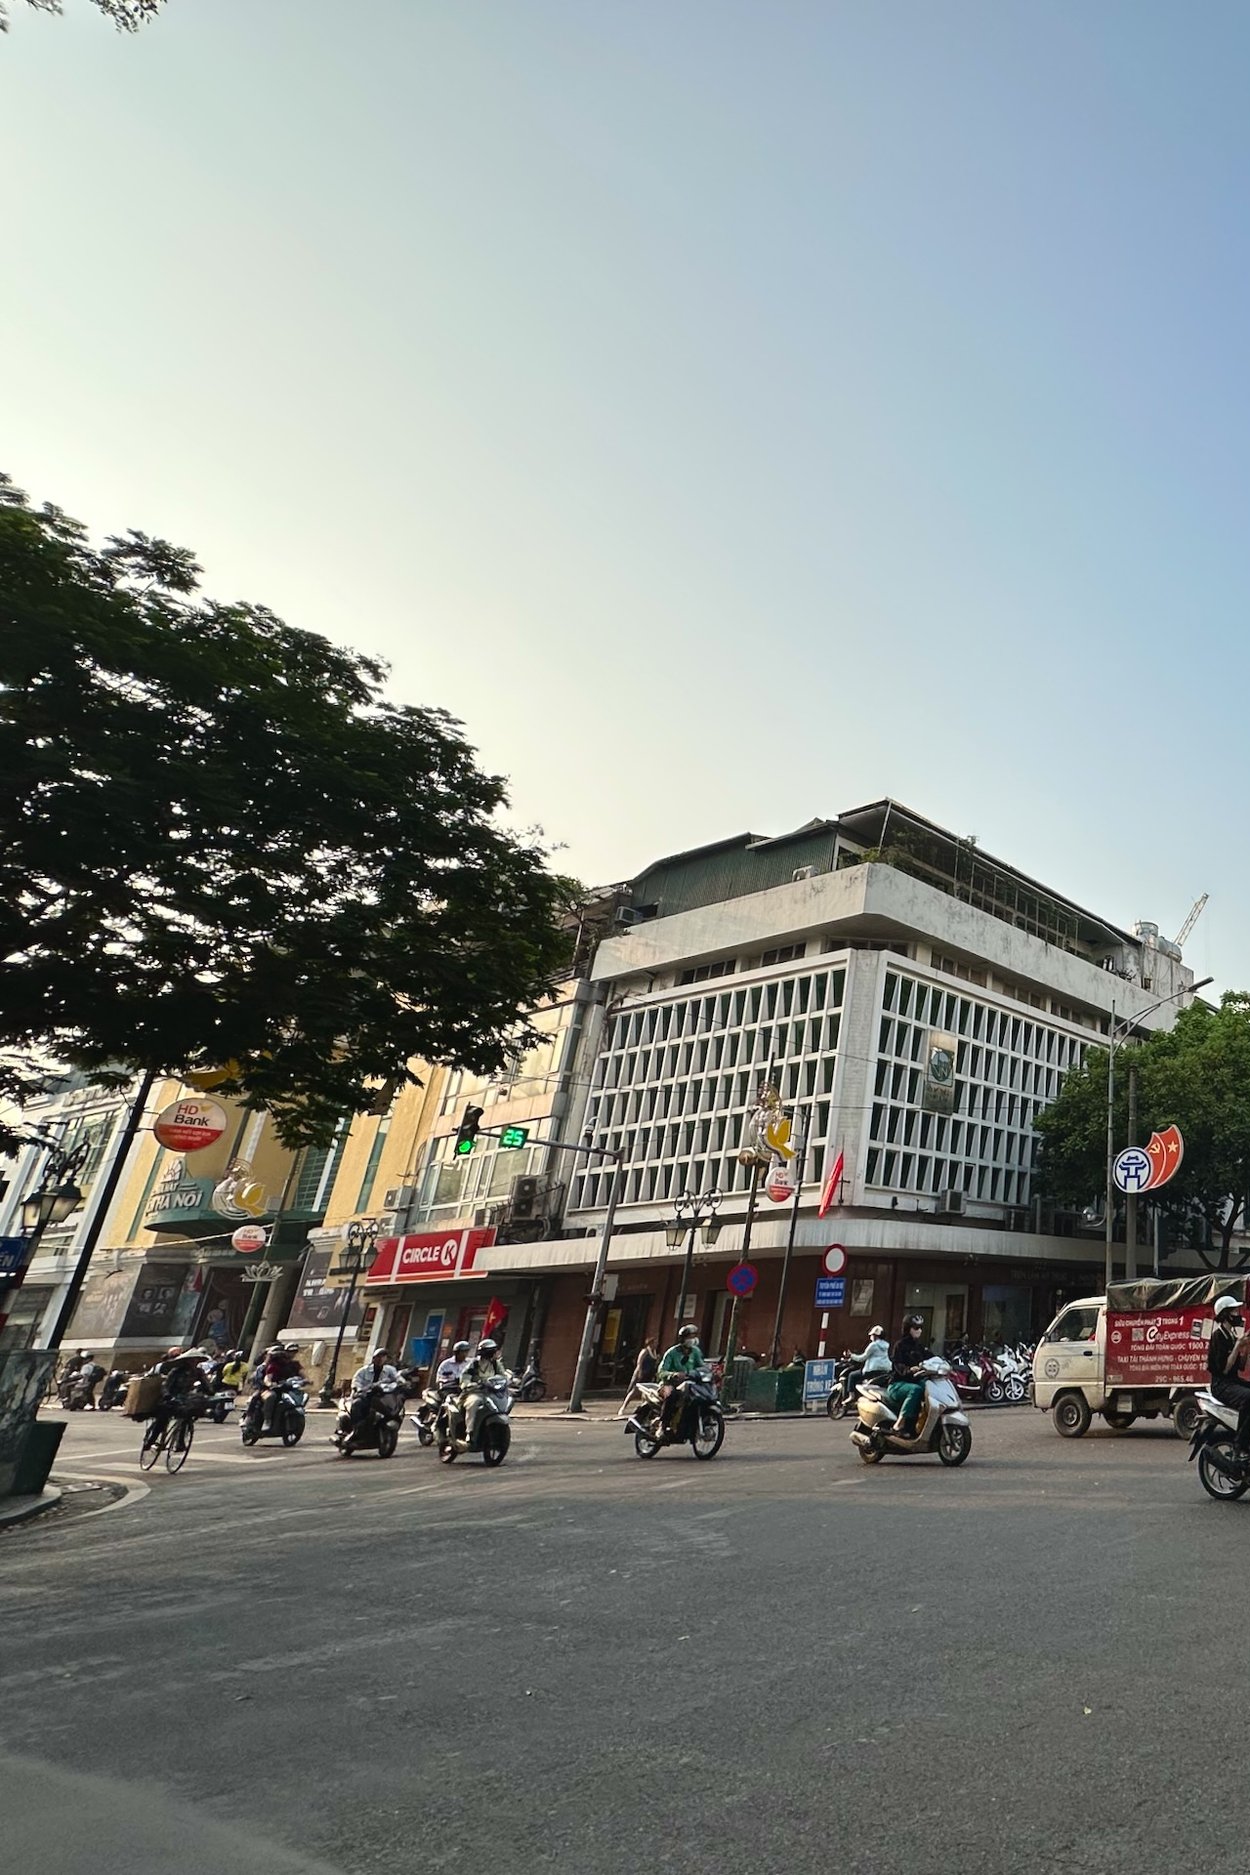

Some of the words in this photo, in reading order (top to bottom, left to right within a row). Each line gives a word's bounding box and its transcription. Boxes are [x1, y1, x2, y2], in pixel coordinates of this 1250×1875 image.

[178, 1104, 199, 1115] HD
[173, 1114, 210, 1127] Bank
[503, 1129, 524, 1146] 25
[402, 1246, 441, 1264] CIRCLE
[441, 1240, 458, 1265] K
[1156, 1317, 1162, 1327] 3
[1179, 1316, 1184, 1326] 1
